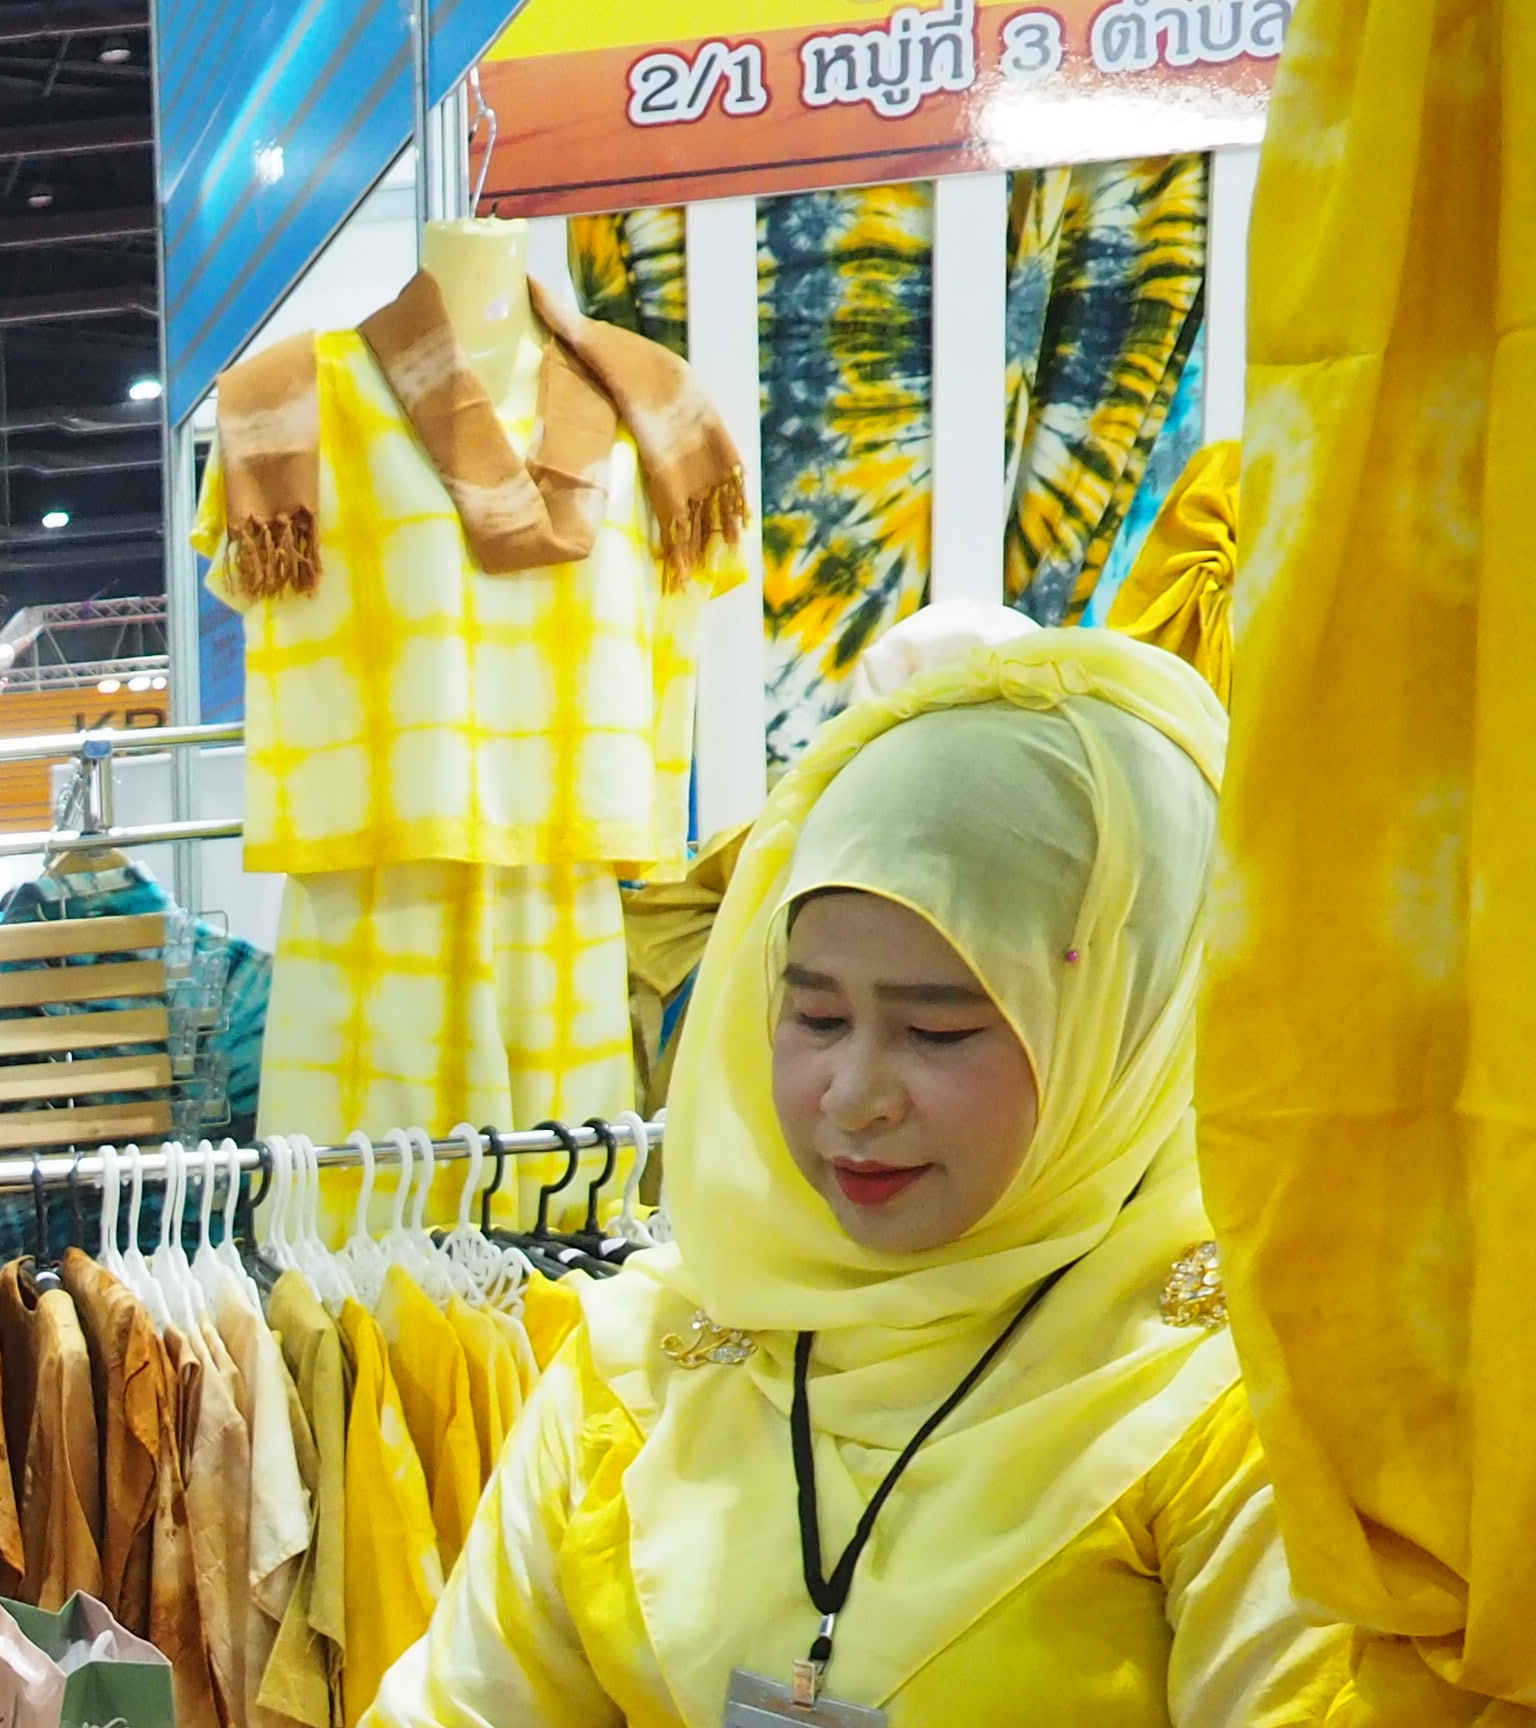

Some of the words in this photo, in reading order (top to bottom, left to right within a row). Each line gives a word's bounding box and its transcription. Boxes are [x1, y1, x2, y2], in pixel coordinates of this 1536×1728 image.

[635, 48, 760, 115] 2/1
[809, 3, 966, 108] หมู่ที่
[1008, 20, 1055, 74] 3
